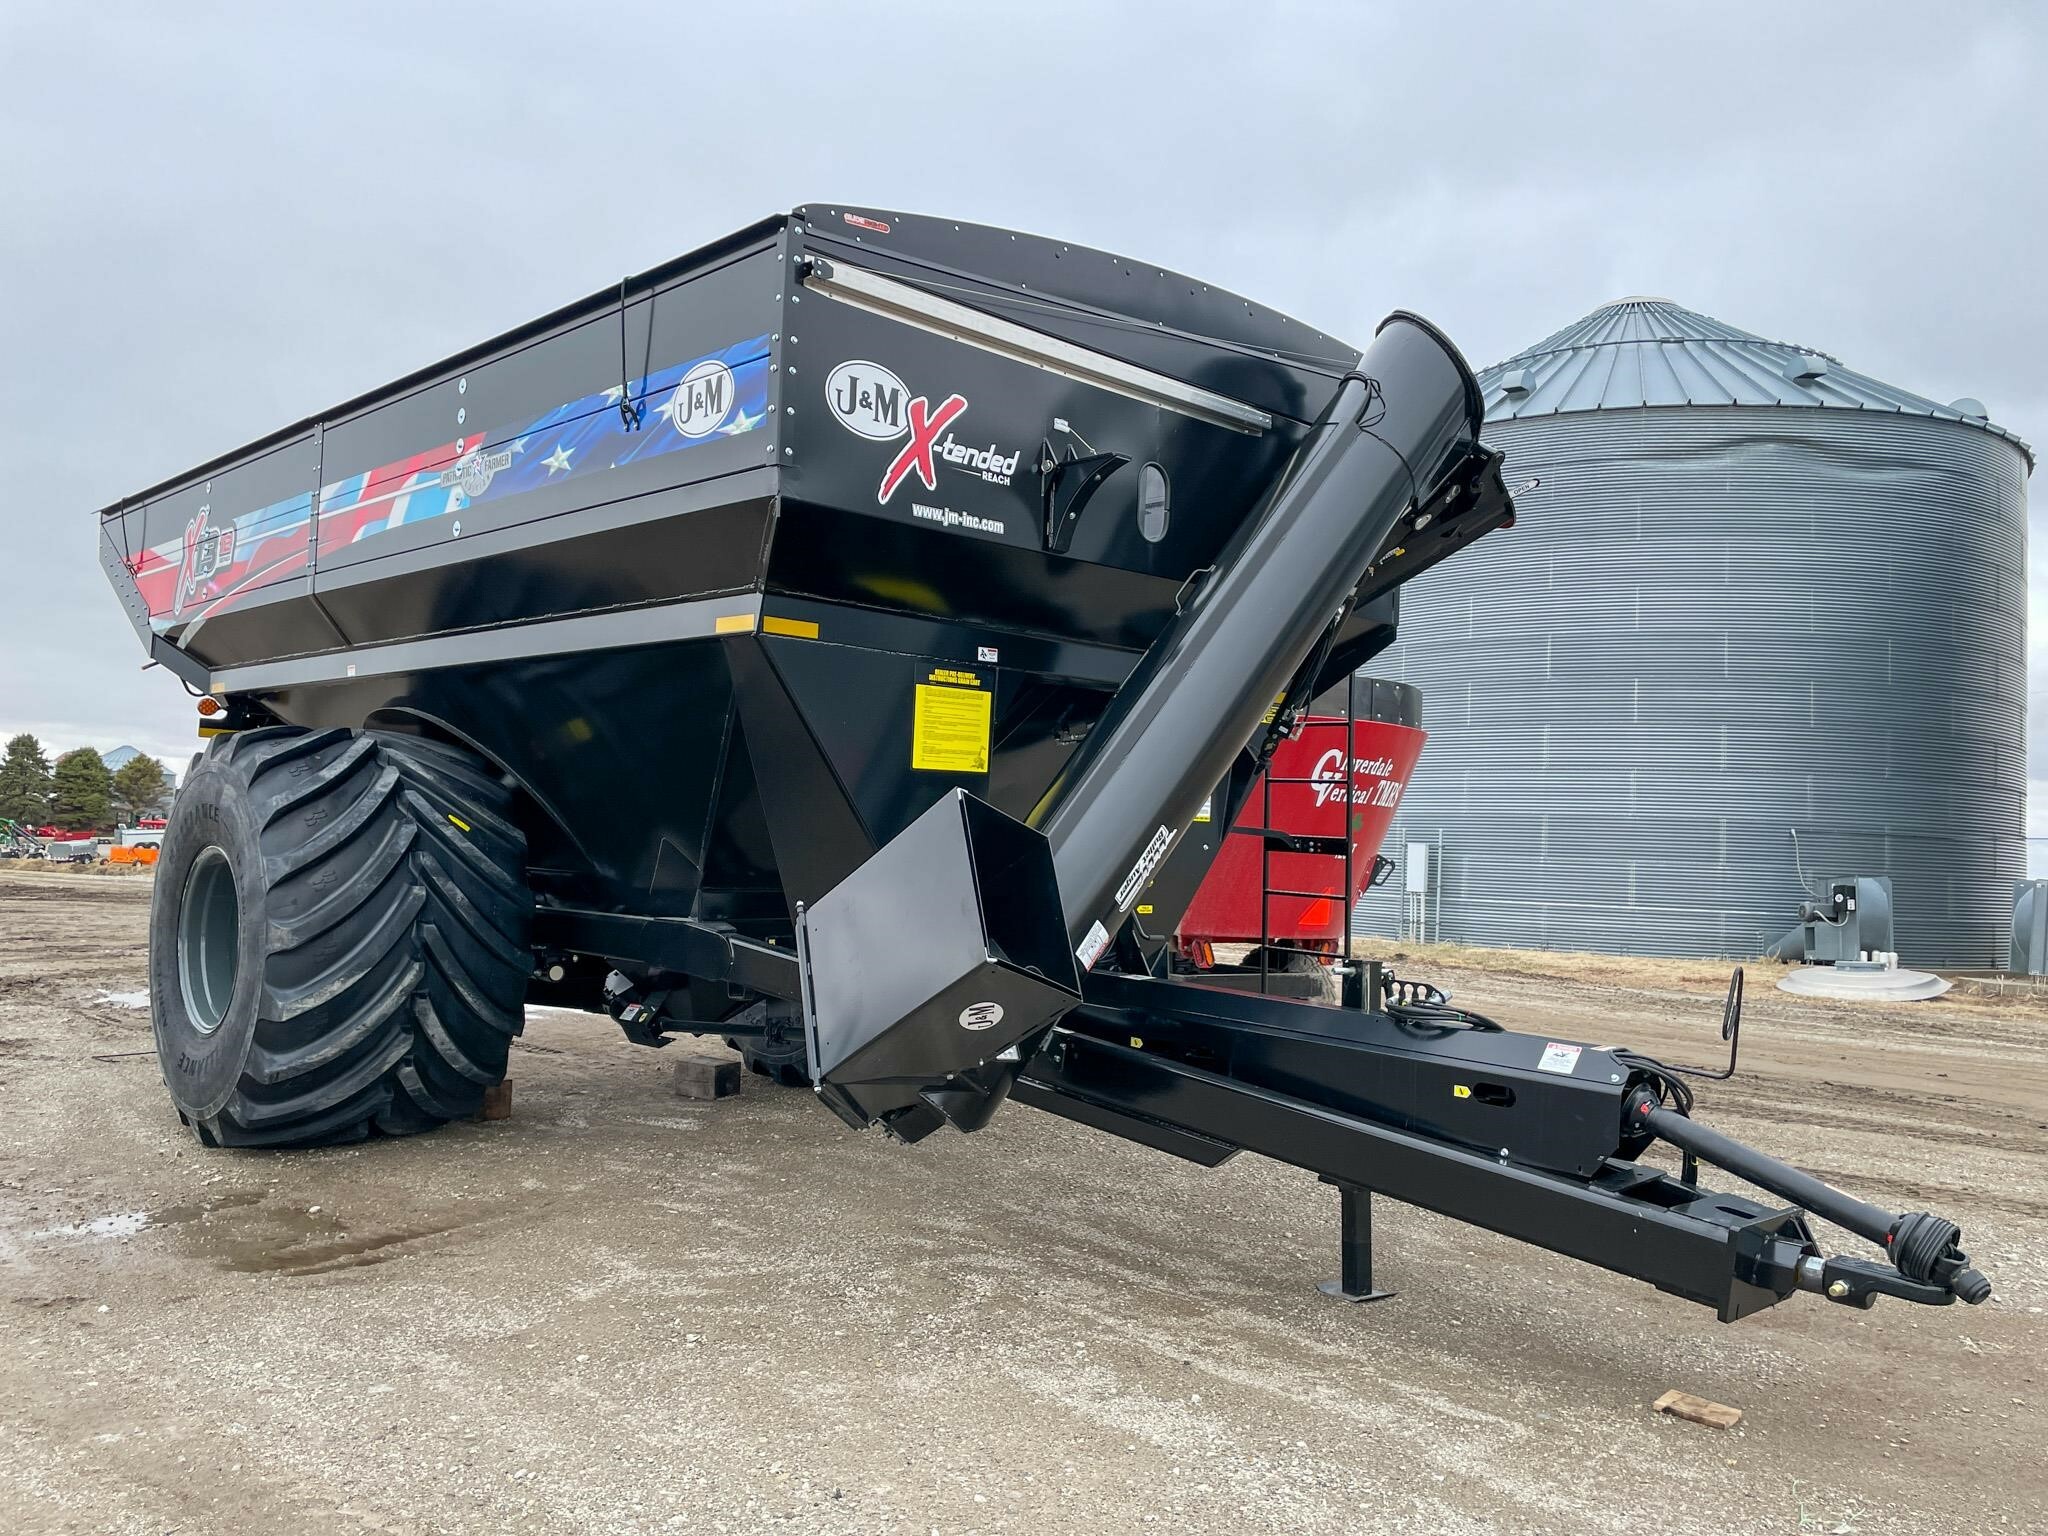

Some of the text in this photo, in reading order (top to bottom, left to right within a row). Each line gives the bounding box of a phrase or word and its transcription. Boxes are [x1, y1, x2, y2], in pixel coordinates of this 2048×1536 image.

[678, 373, 725, 425] J&M
[835, 374, 901, 428] J&M
[484, 453, 510, 471] FARMER
[878, 394, 1021, 505] X-tended
[981, 471, 1011, 486] REACH
[1513, 484, 1530, 495] OPEN
[911, 503, 1004, 534] www.jm-inc.com
[1311, 748, 1394, 792] Clverdale
[1315, 771, 1374, 808] Verical
[1118, 829, 1166, 900] Bullet Auger
[967, 1004, 996, 1029] J&M
